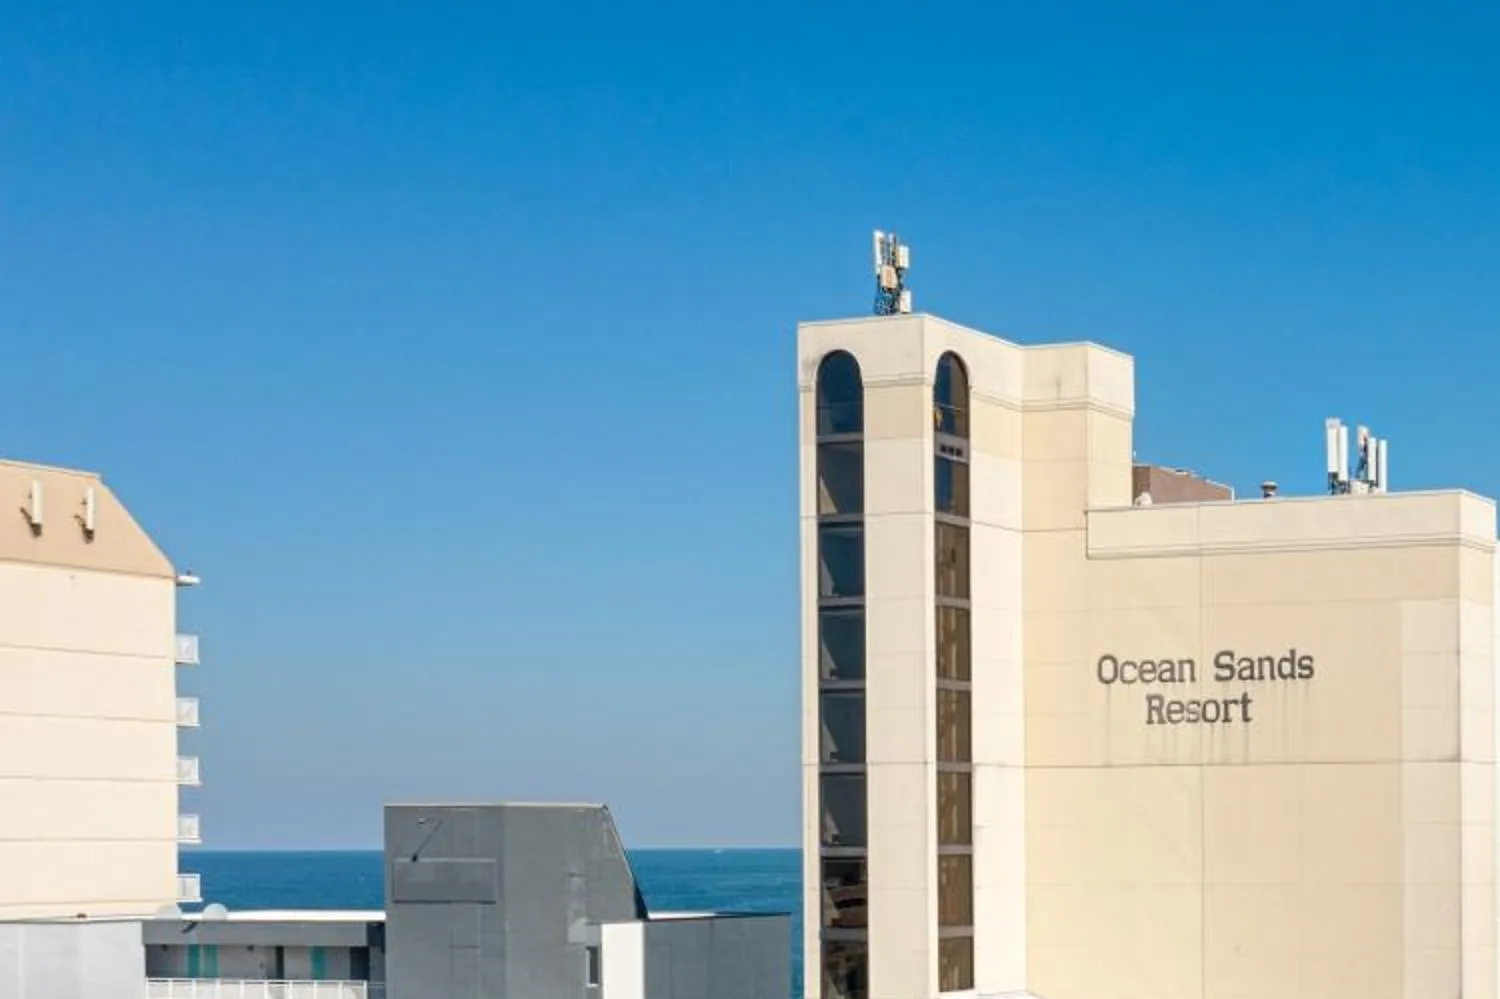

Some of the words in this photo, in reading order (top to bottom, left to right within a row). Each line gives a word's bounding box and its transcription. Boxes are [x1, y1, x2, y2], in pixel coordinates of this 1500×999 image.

[1097, 654, 1196, 684] Ocean
[1213, 648, 1315, 682] Sands
[1145, 691, 1253, 725] Resort
